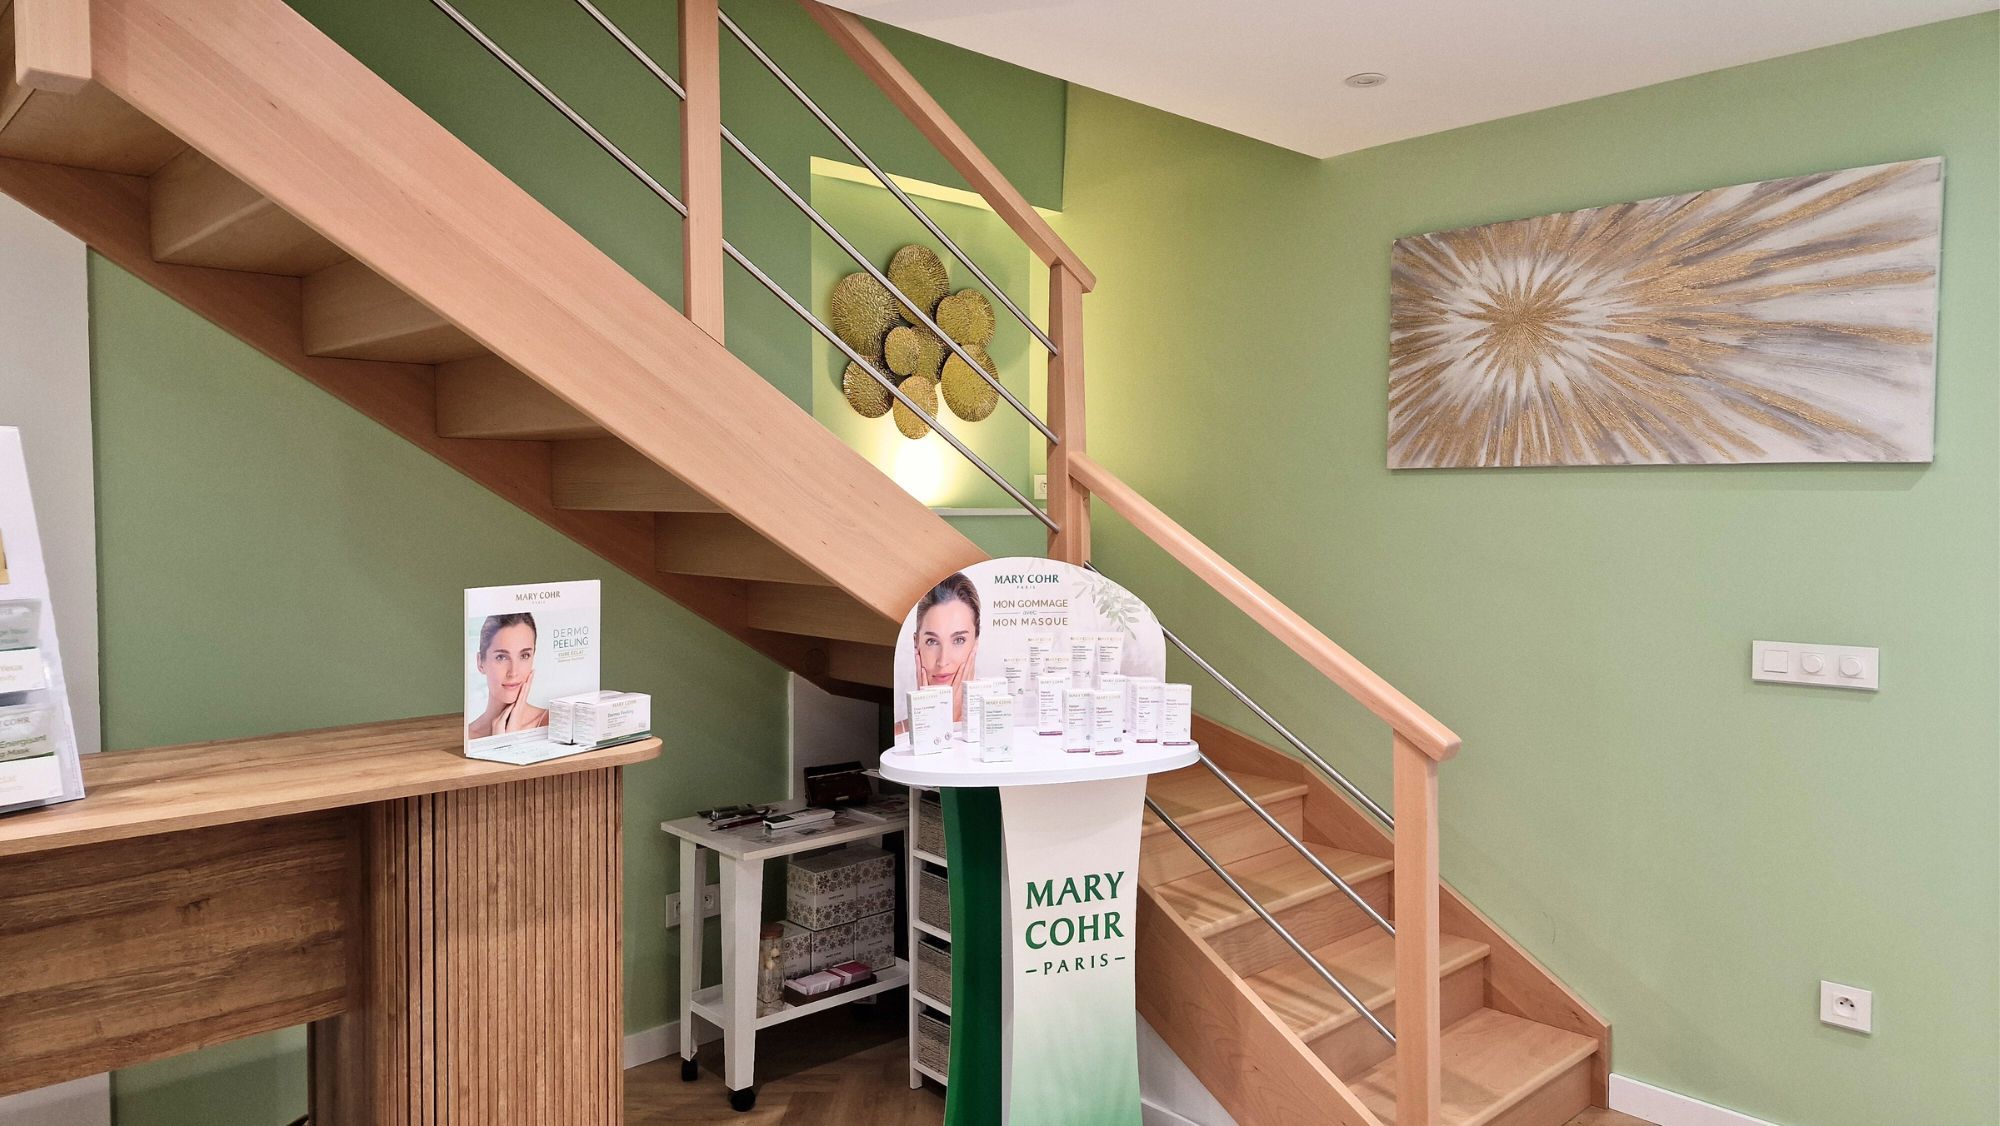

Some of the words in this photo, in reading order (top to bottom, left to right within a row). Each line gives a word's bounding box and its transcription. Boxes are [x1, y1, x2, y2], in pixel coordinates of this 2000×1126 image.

[994, 574, 1025, 584] MARY
[1027, 574, 1060, 584] COHR
[515, 592, 538, 601] MARY
[539, 590, 561, 600] COHR
[993, 600, 1015, 609] MON
[1017, 599, 1069, 608] GOMMAGE
[992, 618, 1017, 627] MON
[1021, 617, 1069, 626] MASQUE
[553, 626, 589, 639] DERMO
[553, 636, 589, 649] PEELING
[1025, 871, 1125, 910] MARY
[1025, 911, 1125, 950] COHR
[1043, 953, 1109, 976] PARIS
